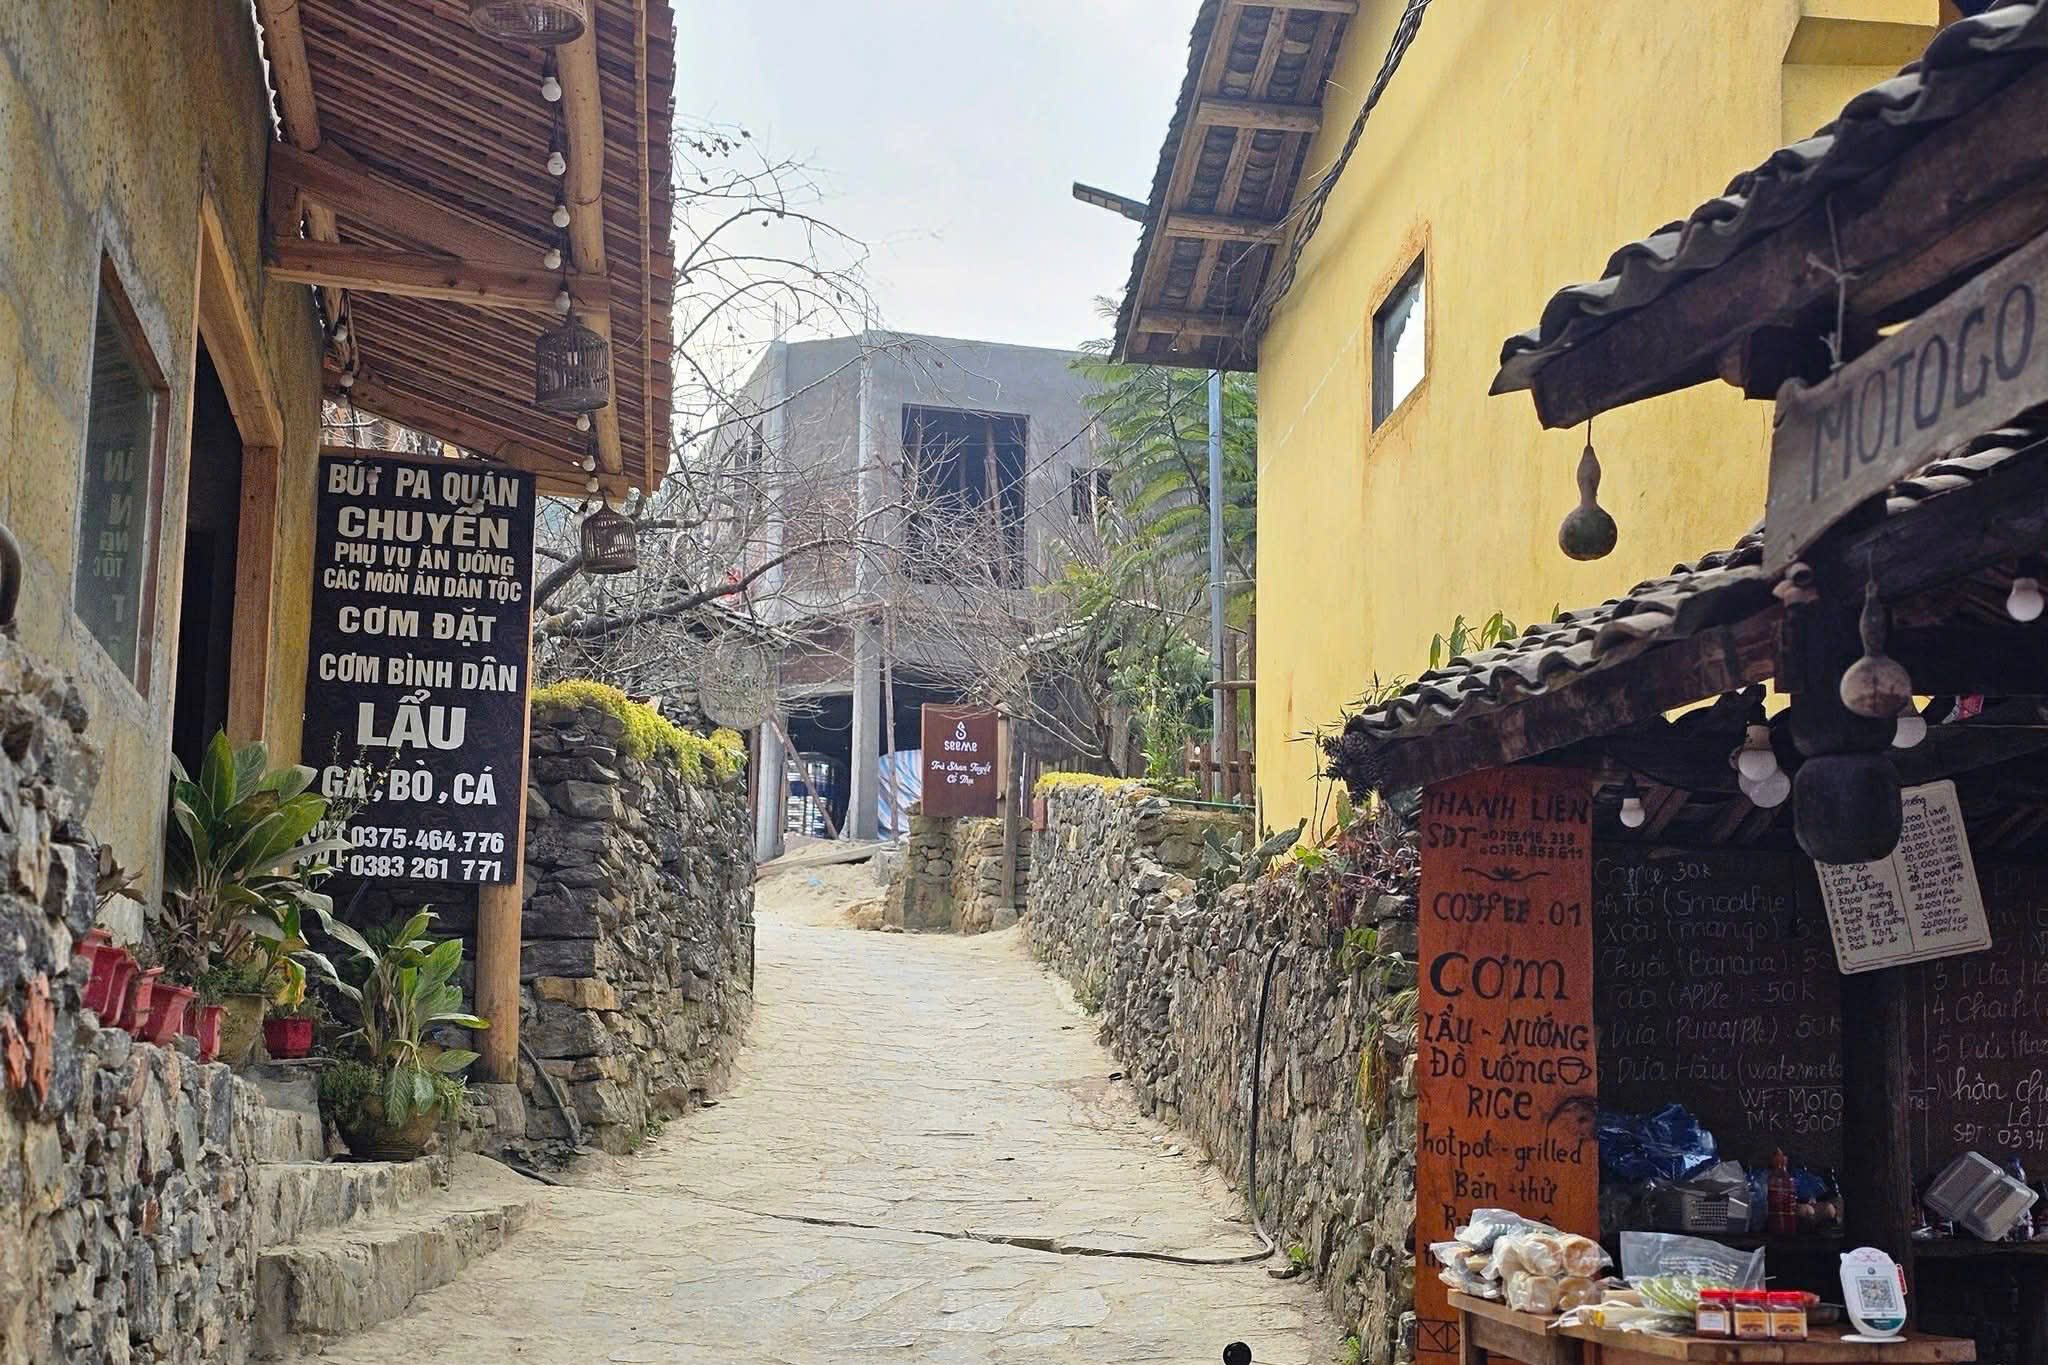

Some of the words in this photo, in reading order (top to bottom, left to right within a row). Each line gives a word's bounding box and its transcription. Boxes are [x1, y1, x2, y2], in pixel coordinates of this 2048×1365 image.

[1809, 283, 2035, 503] MOTOGO
[395, 467, 431, 499] PA
[442, 470, 519, 508] QUÁN
[334, 541, 376, 568] PHỤ
[383, 546, 411, 572] VỤ
[418, 544, 450, 570] ĂN
[457, 549, 514, 576] UỐNG
[413, 571, 439, 597] ĂN
[444, 573, 482, 599] DÂN
[488, 577, 522, 604] TỘC
[338, 605, 419, 638] CƠM
[432, 607, 497, 647] ĐẶT
[319, 652, 379, 683] CƠM
[388, 651, 452, 689] BÌNH
[461, 656, 518, 692] DÂN
[357, 689, 467, 750] LẨU
[350, 854, 404, 878] 0383
[410, 857, 448, 879] 261
[461, 859, 501, 881] 771
[1422, 1122, 1494, 1168] hotpot
[1514, 1138, 1583, 1172] grilled
